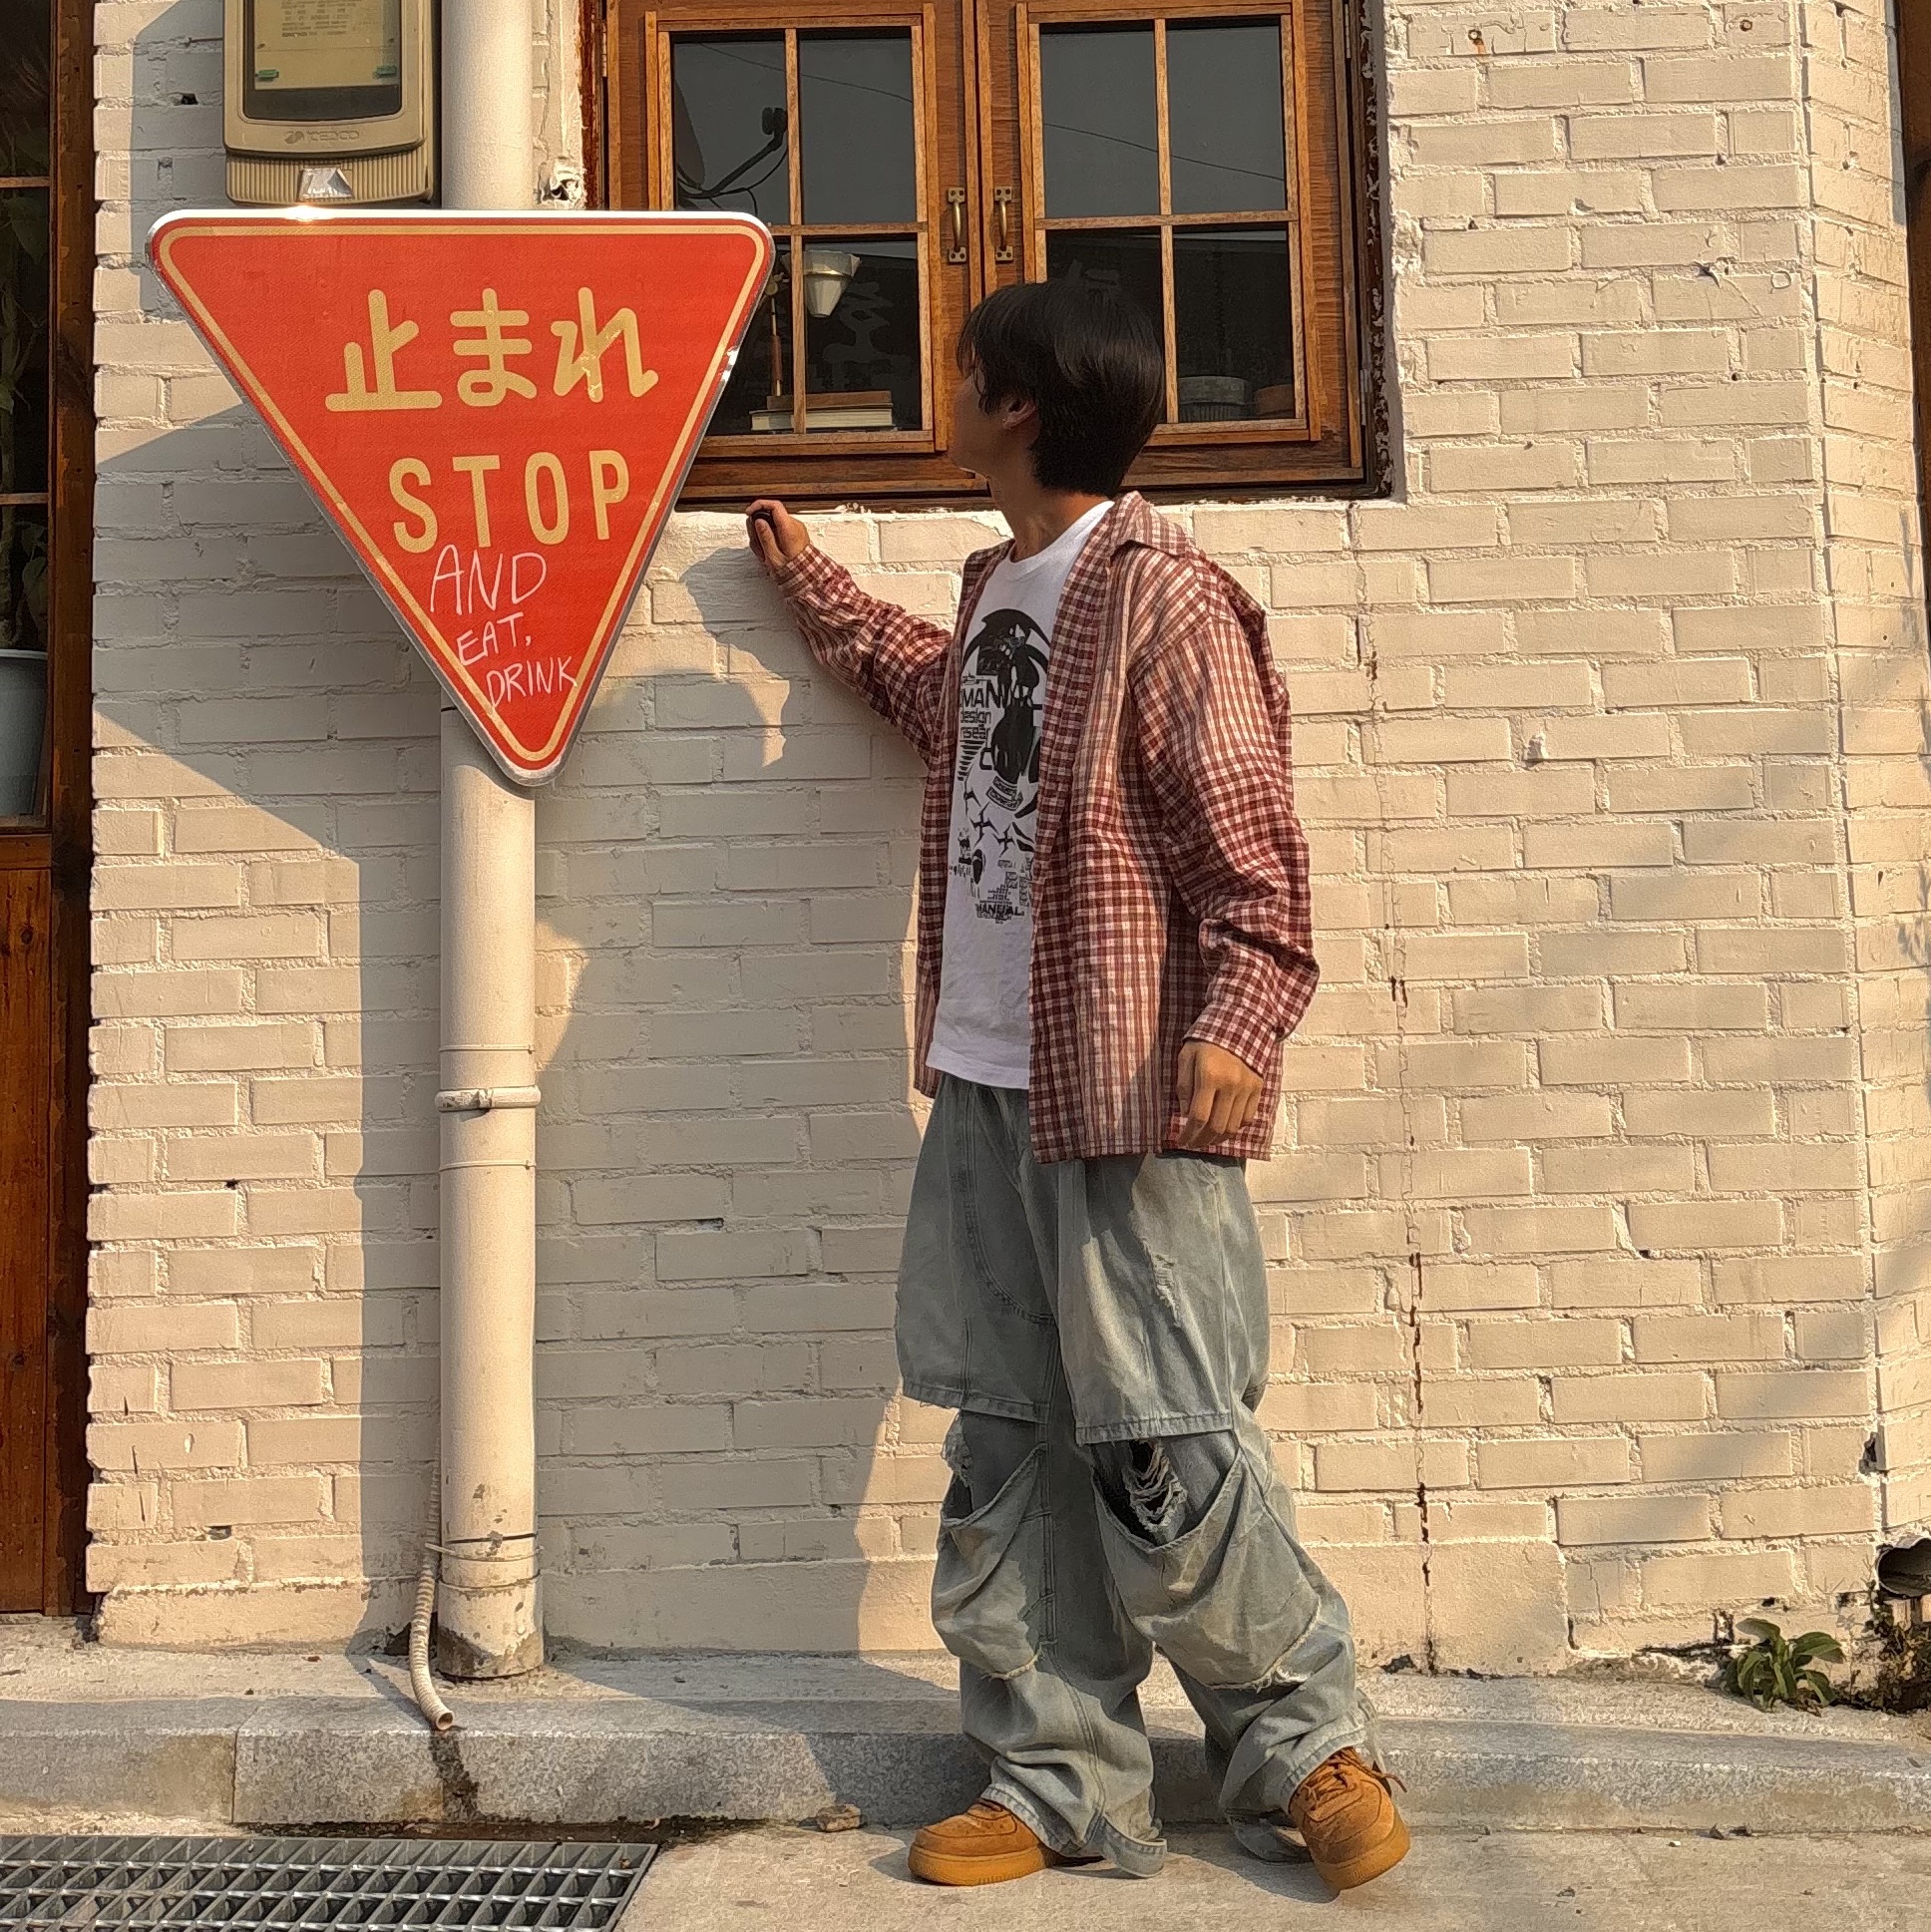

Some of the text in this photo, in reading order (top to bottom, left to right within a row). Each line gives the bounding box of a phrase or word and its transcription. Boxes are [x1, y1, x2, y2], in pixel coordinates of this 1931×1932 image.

[325, 287, 658, 412] 止まれ
[389, 449, 630, 554] STOP
[430, 545, 547, 616] AND
[486, 655, 578, 709] DRINK
